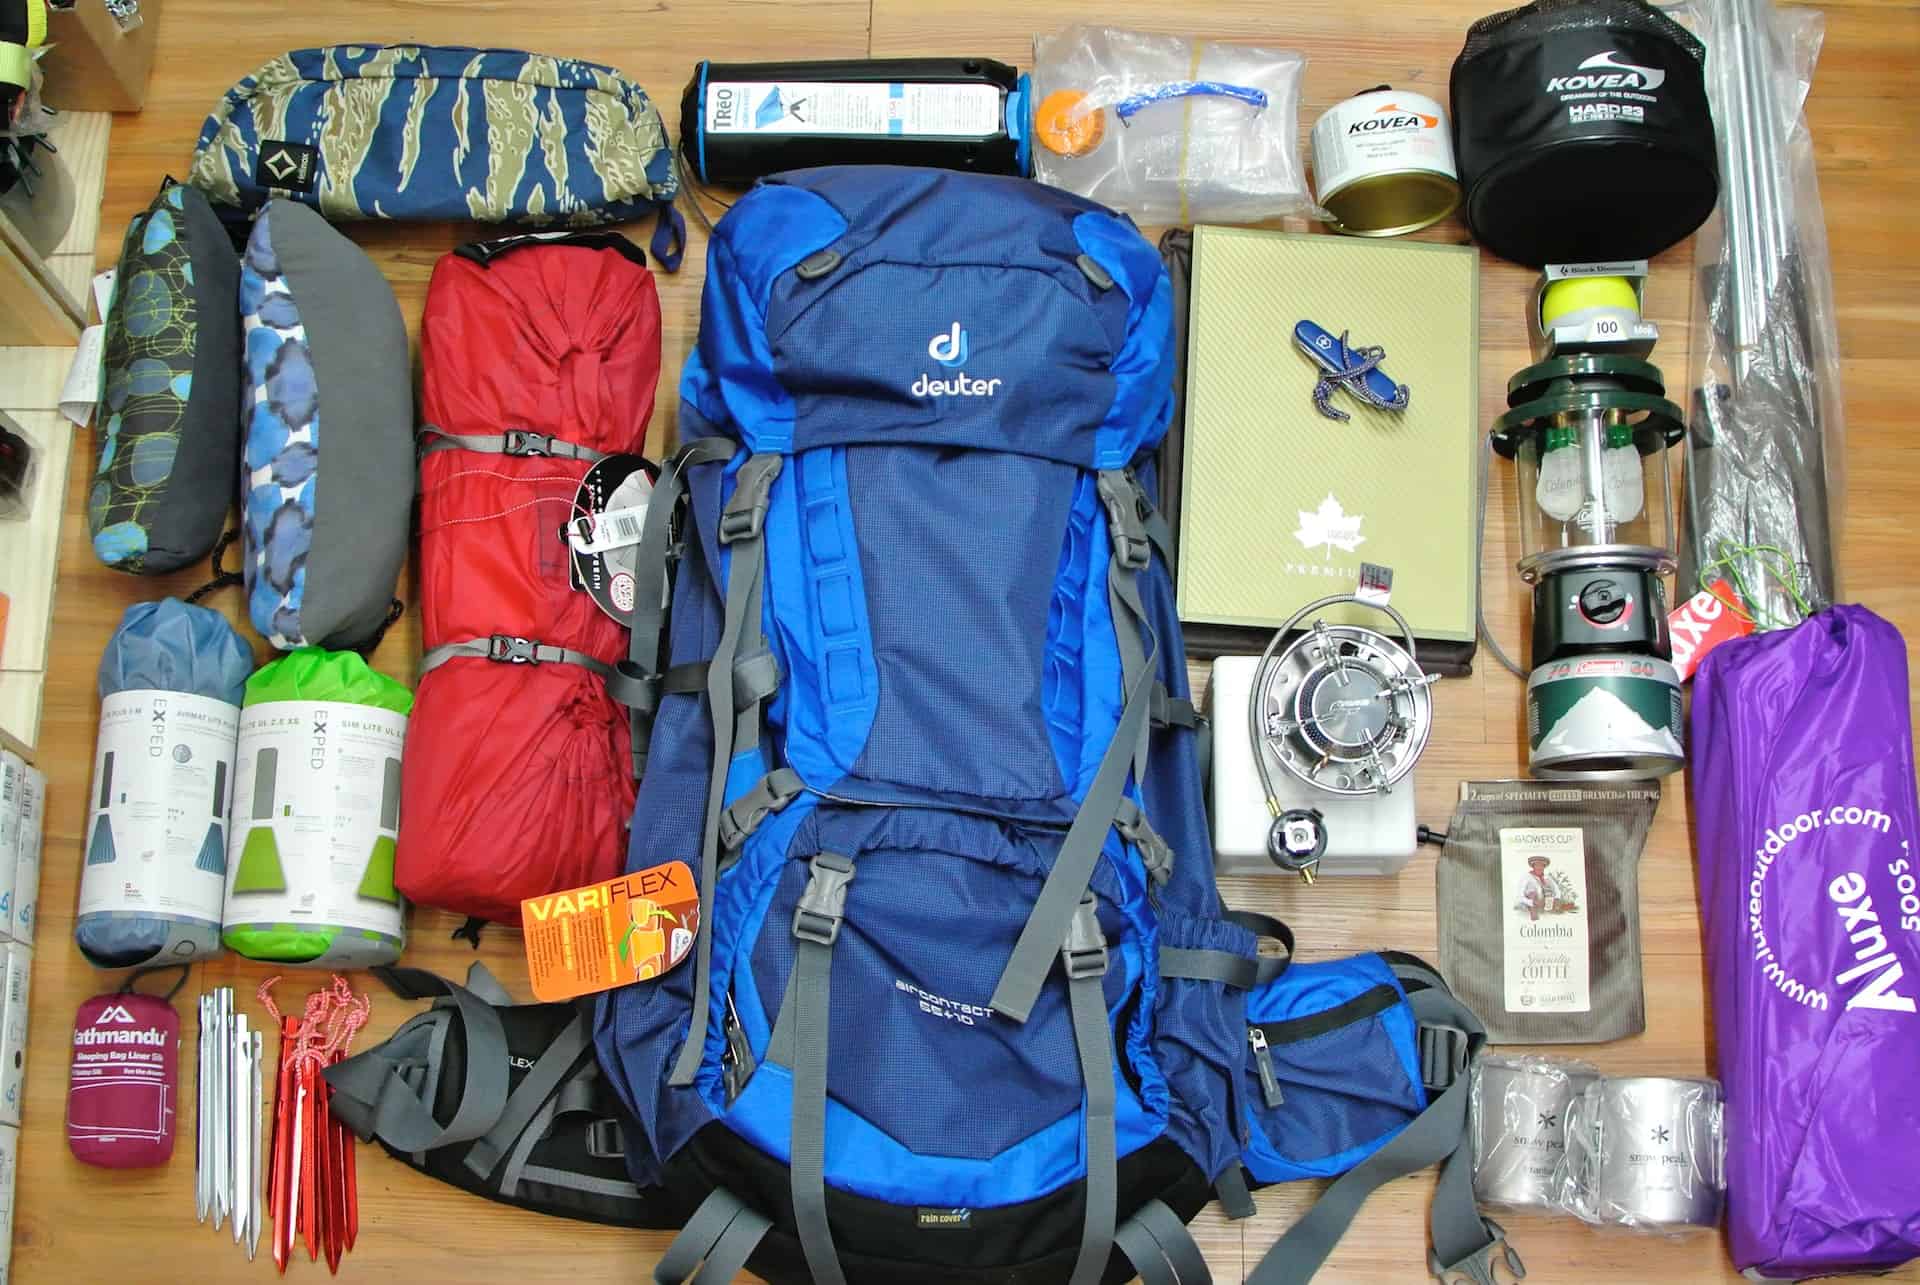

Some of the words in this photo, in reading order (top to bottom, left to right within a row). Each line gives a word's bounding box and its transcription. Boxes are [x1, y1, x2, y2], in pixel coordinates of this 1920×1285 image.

[1546, 72, 1640, 93] KOVEA
[1348, 116, 1419, 135] KOVEA
[1596, 320, 1618, 335] 100
[911, 371, 1002, 397] deuter
[149, 698, 167, 757] EXPED
[311, 709, 328, 770] EXPED
[1519, 924, 1574, 938] Colombia
[74, 1027, 165, 1047] athmandu
